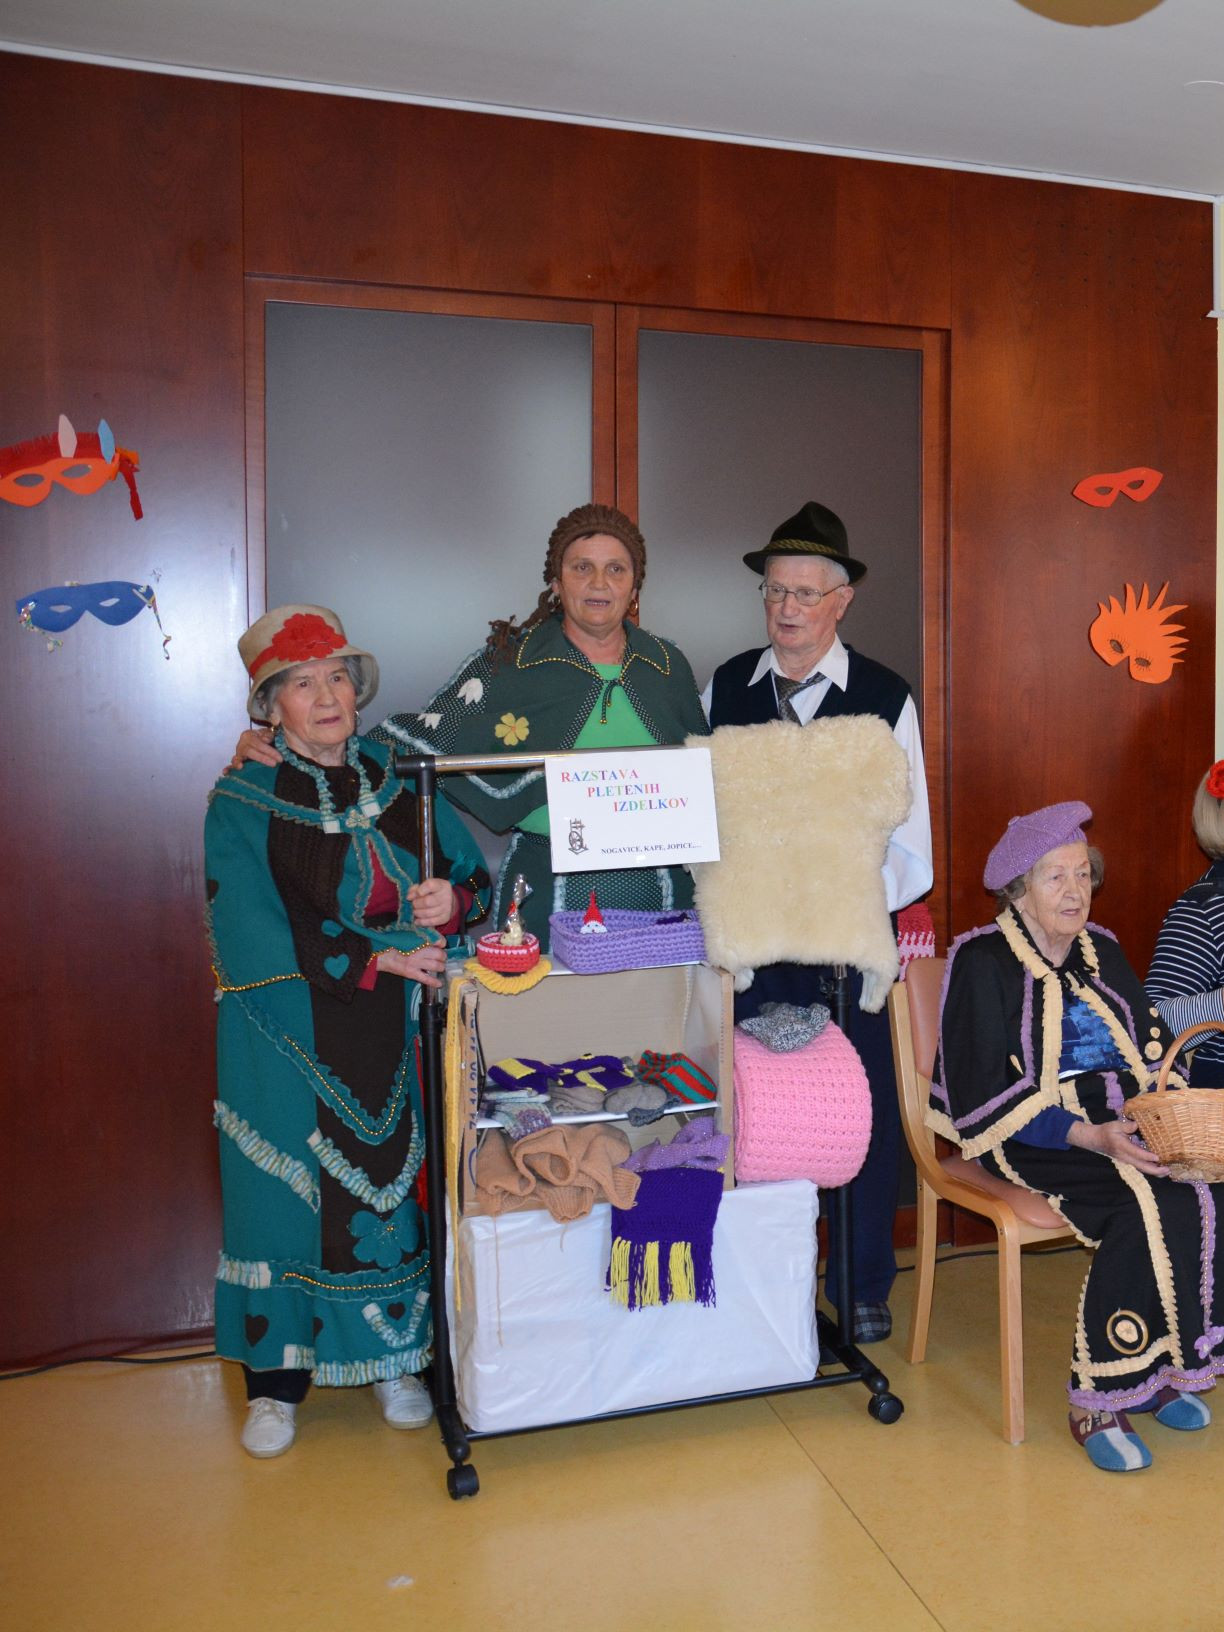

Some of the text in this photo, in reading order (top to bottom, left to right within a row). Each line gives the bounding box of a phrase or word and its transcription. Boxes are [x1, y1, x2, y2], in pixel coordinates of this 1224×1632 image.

[561, 769, 639, 783] RAZSTAVA
[587, 783, 660, 798] PLETENIH
[613, 798, 689, 812] IZDELKOV
[600, 846, 642, 855] NOGAVICE,
[644, 844, 666, 853] KAPE,
